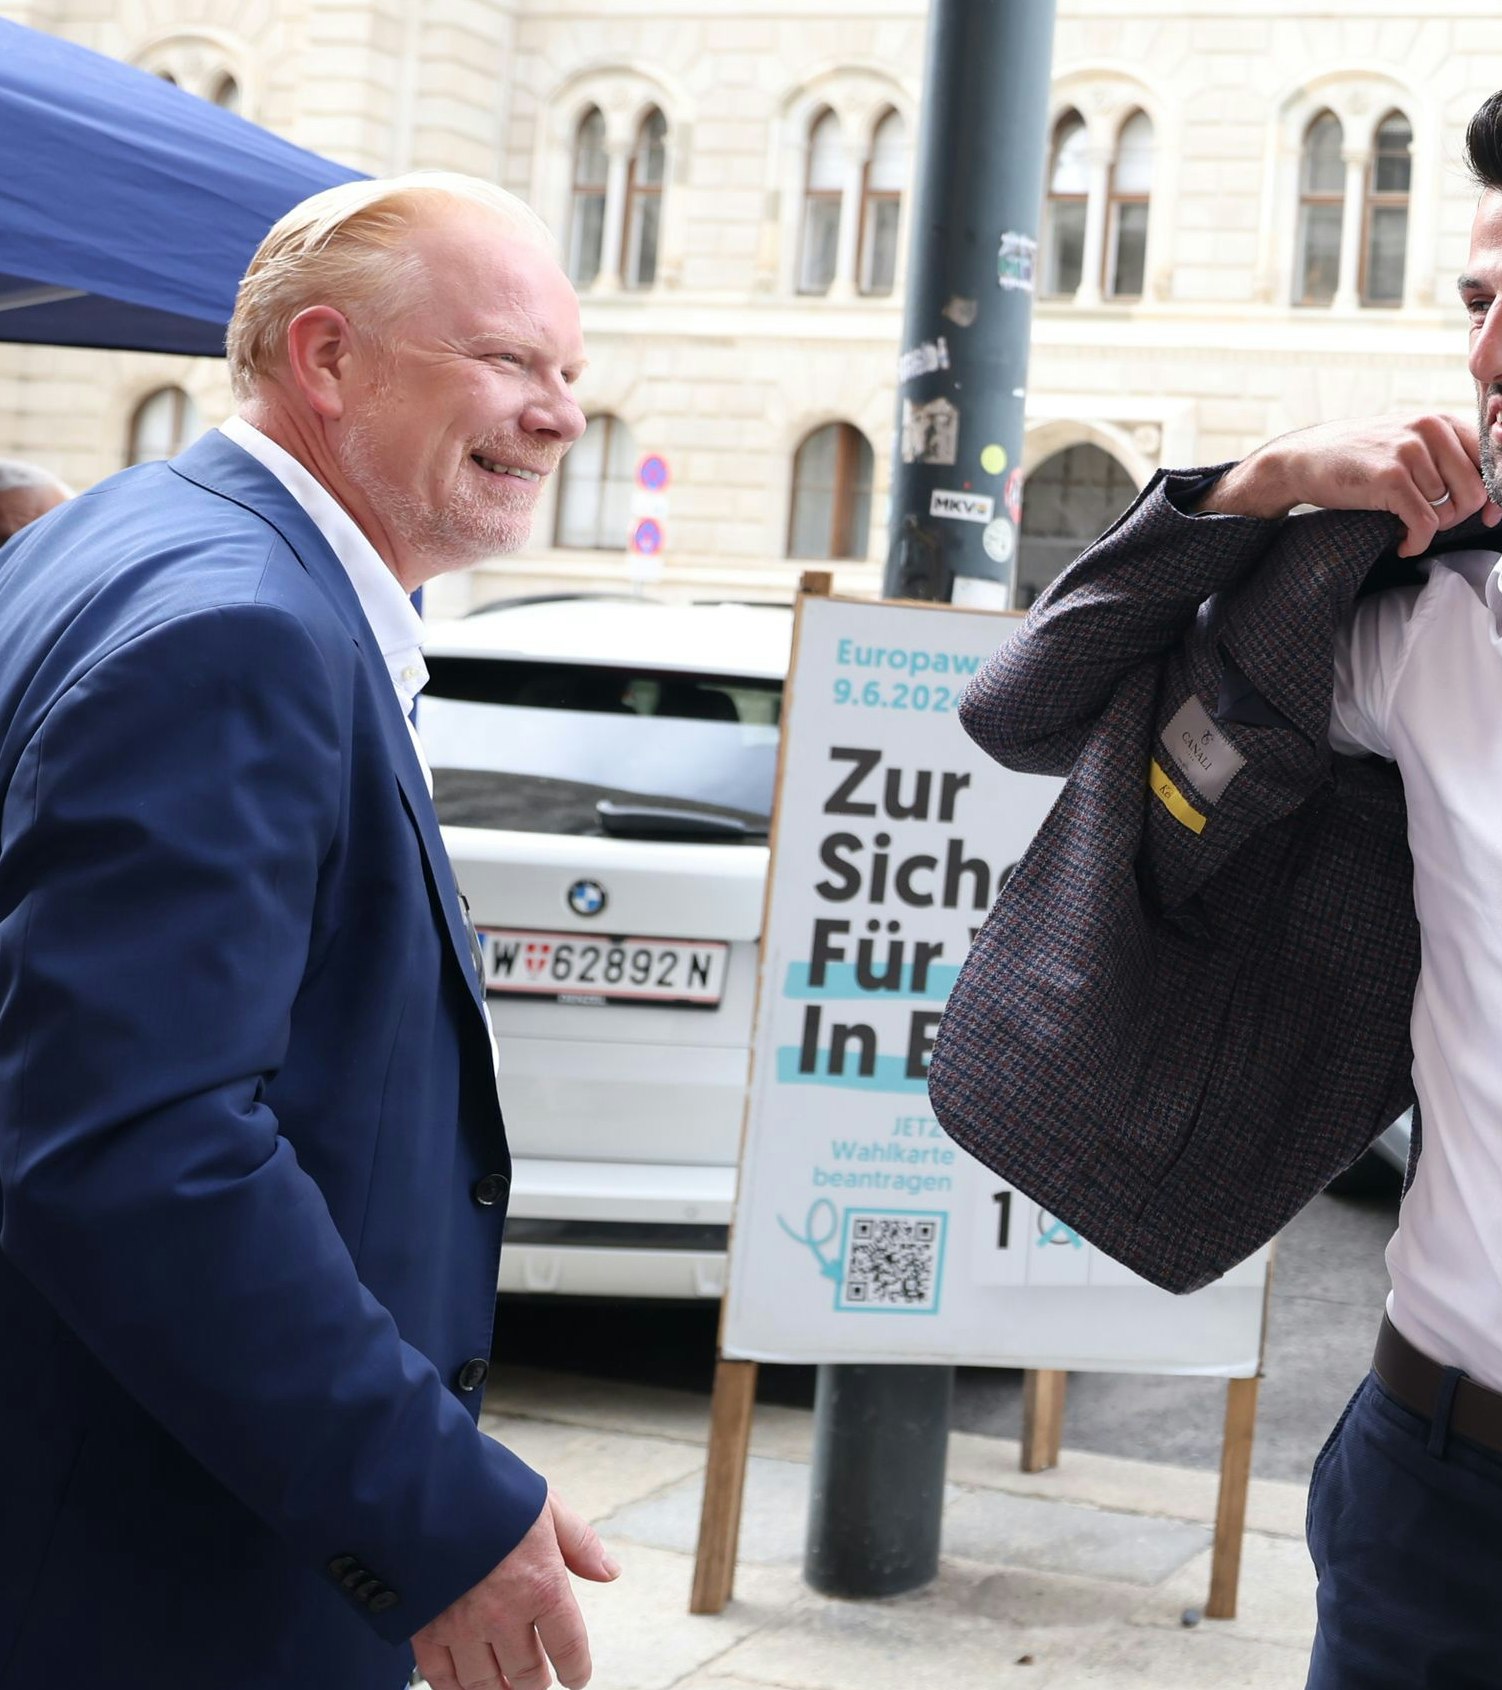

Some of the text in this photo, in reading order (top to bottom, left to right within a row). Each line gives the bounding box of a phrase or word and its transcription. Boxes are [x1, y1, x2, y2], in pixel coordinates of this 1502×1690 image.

[836, 638, 980, 677] Europaw
[1182, 731, 1212, 771] CANALI
[823, 747, 971, 823] Zur
[807, 918, 944, 994] Für
[799, 1004, 877, 1078] In
[891, 1116, 942, 1138] JETZ
[832, 1140, 955, 1165] Wahlkarte
[813, 1167, 953, 1195] beantragen
[992, 1191, 1011, 1249] 1
